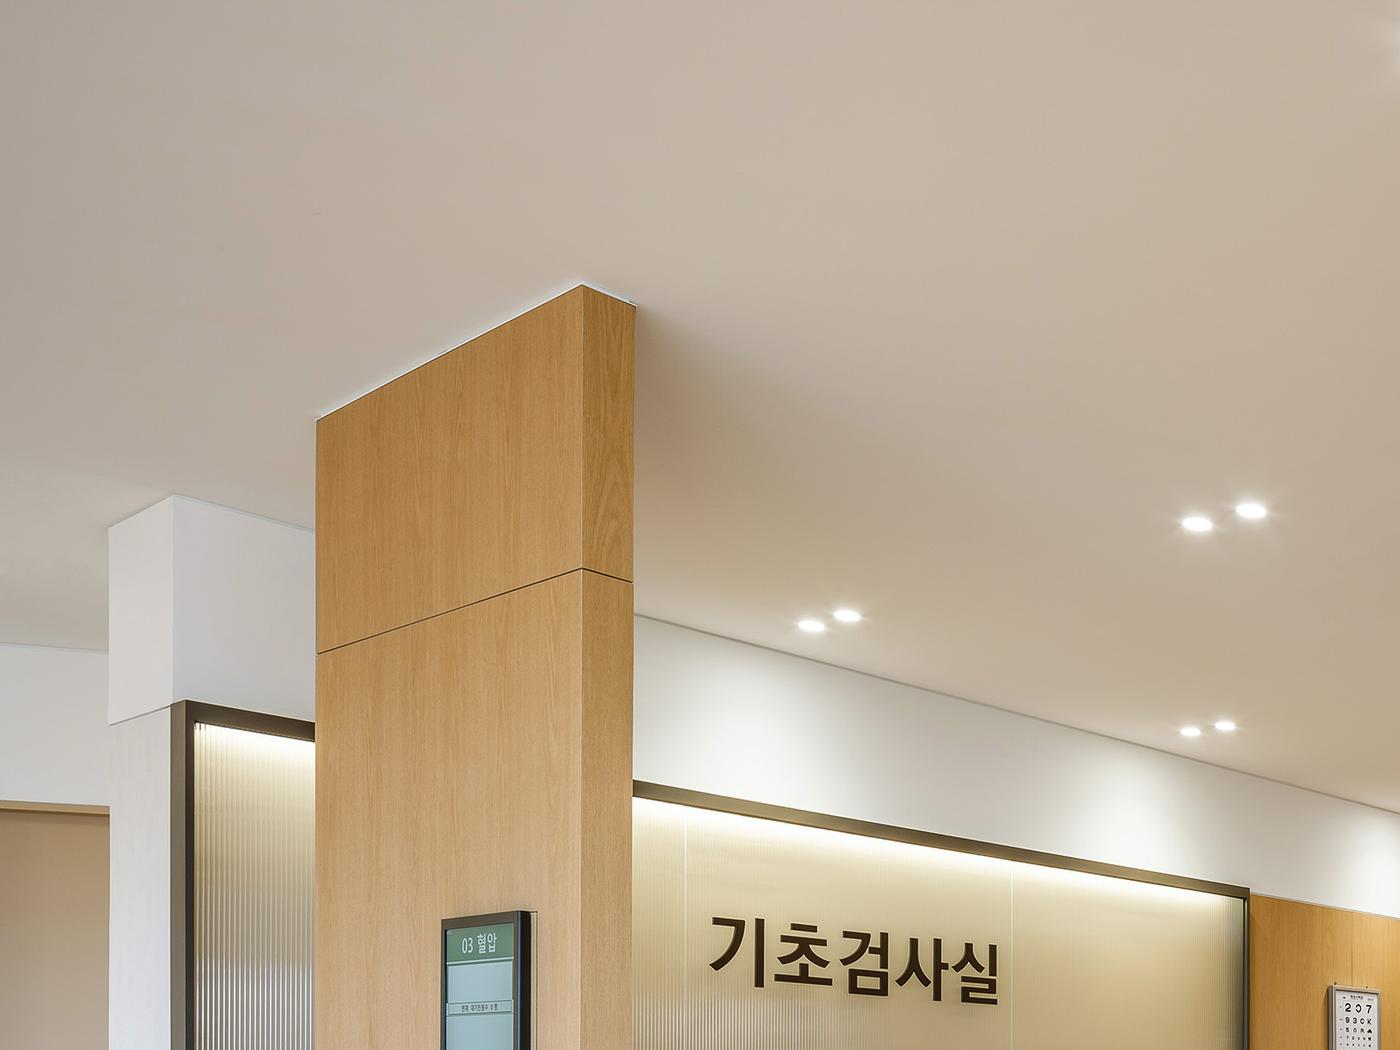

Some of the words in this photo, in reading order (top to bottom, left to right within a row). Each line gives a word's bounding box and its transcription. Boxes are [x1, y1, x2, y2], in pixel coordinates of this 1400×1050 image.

[461, 937, 474, 954] 03
[477, 932, 497, 954] 혈압
[709, 916, 998, 1005] 기초검사실
